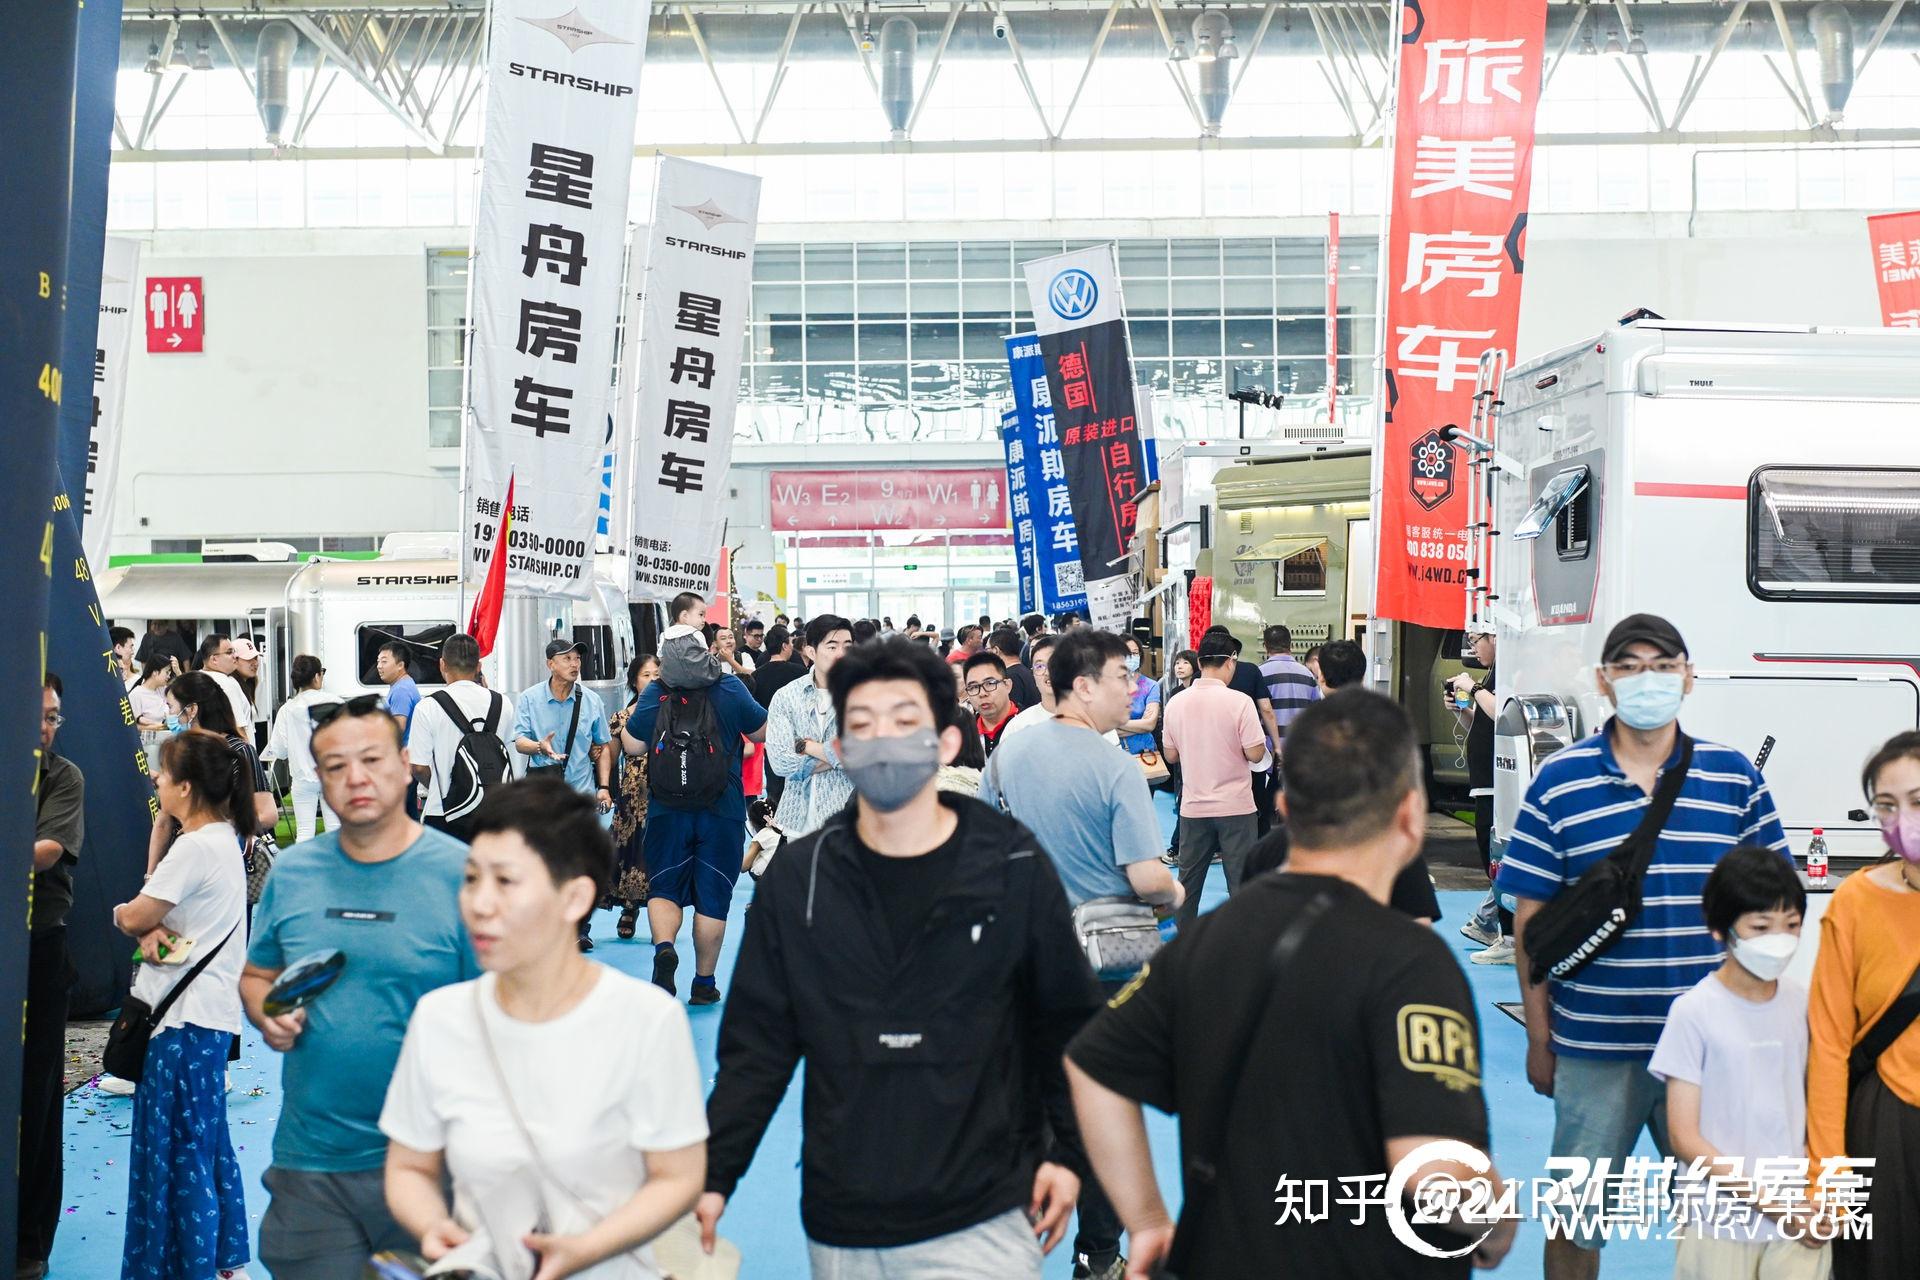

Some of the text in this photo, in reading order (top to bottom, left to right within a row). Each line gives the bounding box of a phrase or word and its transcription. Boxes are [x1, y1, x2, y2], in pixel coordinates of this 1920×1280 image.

[509, 62, 634, 98] STARSHIP
[1396, 38, 1527, 392] 旅美房车
[665, 236, 746, 260] STARSHIP
[511, 142, 594, 438] 星舟房车
[658, 291, 722, 495] 星舟房车
[1058, 352, 1090, 411] 德国
[1689, 380, 1714, 388] THULE
[1064, 415, 1135, 446] 原装进口
[776, 484, 810, 506] W3
[821, 484, 850, 506] E2
[926, 483, 959, 505] W1
[1008, 439, 1036, 569] 康派斯房车
[1109, 441, 1138, 542] 自行房
[1421, 542, 1444, 560] 838
[357, 575, 459, 586] STARSHIP
[1550, 920, 1618, 976] CONVERSE
